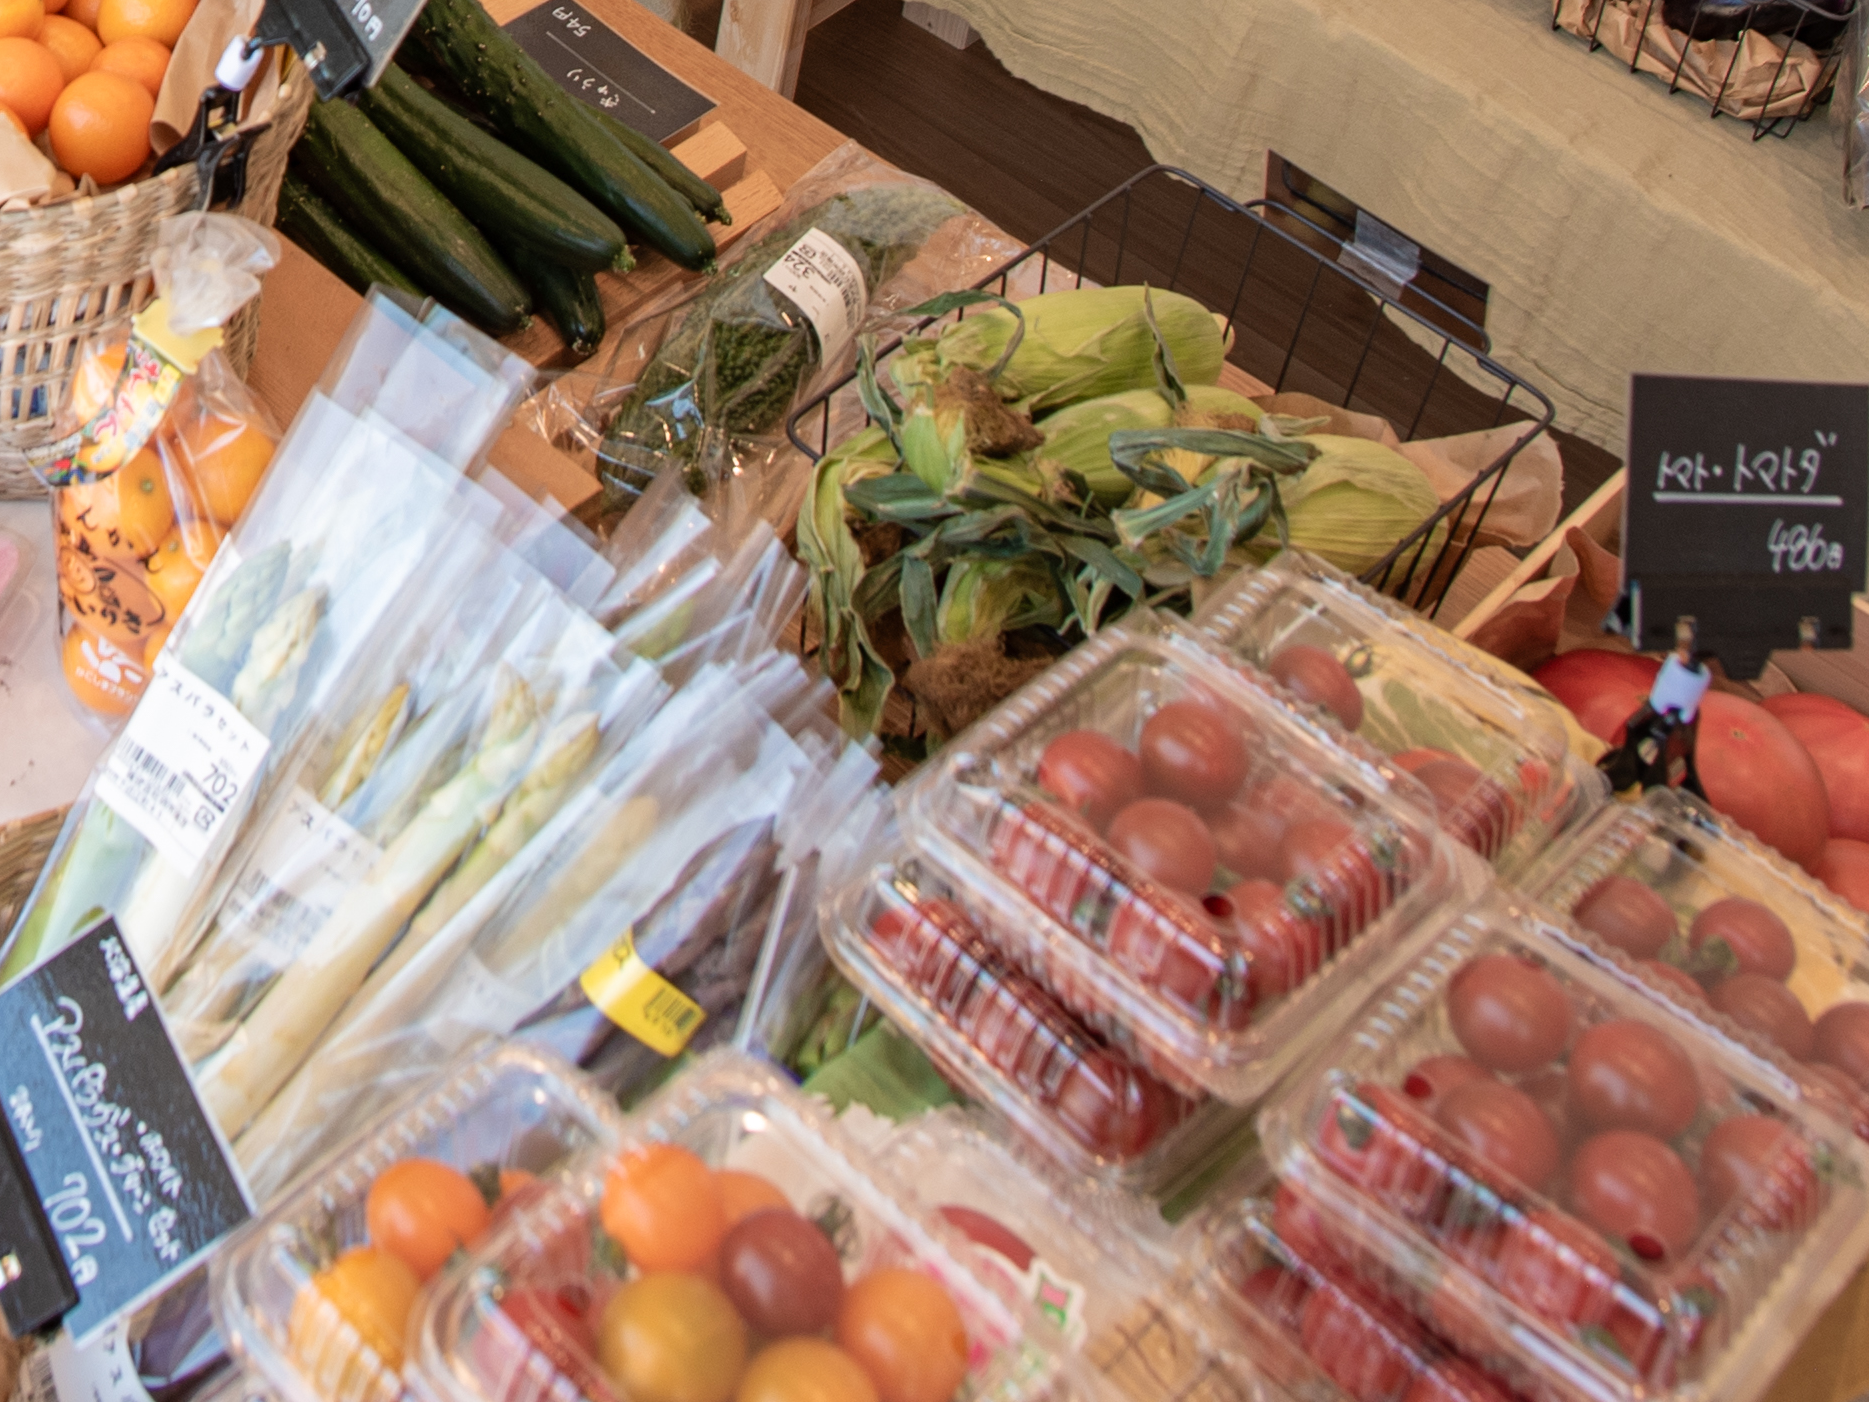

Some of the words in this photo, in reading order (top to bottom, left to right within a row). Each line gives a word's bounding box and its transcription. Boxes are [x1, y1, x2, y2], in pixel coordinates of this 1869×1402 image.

[552, 7, 591, 37] 54円
[567, 69, 619, 108] きゅうり
[785, 255, 810, 278] 324
[1767, 518, 1843, 573] 486円
[157, 668, 250, 751] アスパラセット
[202, 763, 238, 799] 702
[44, 1172, 106, 1287] 702円
